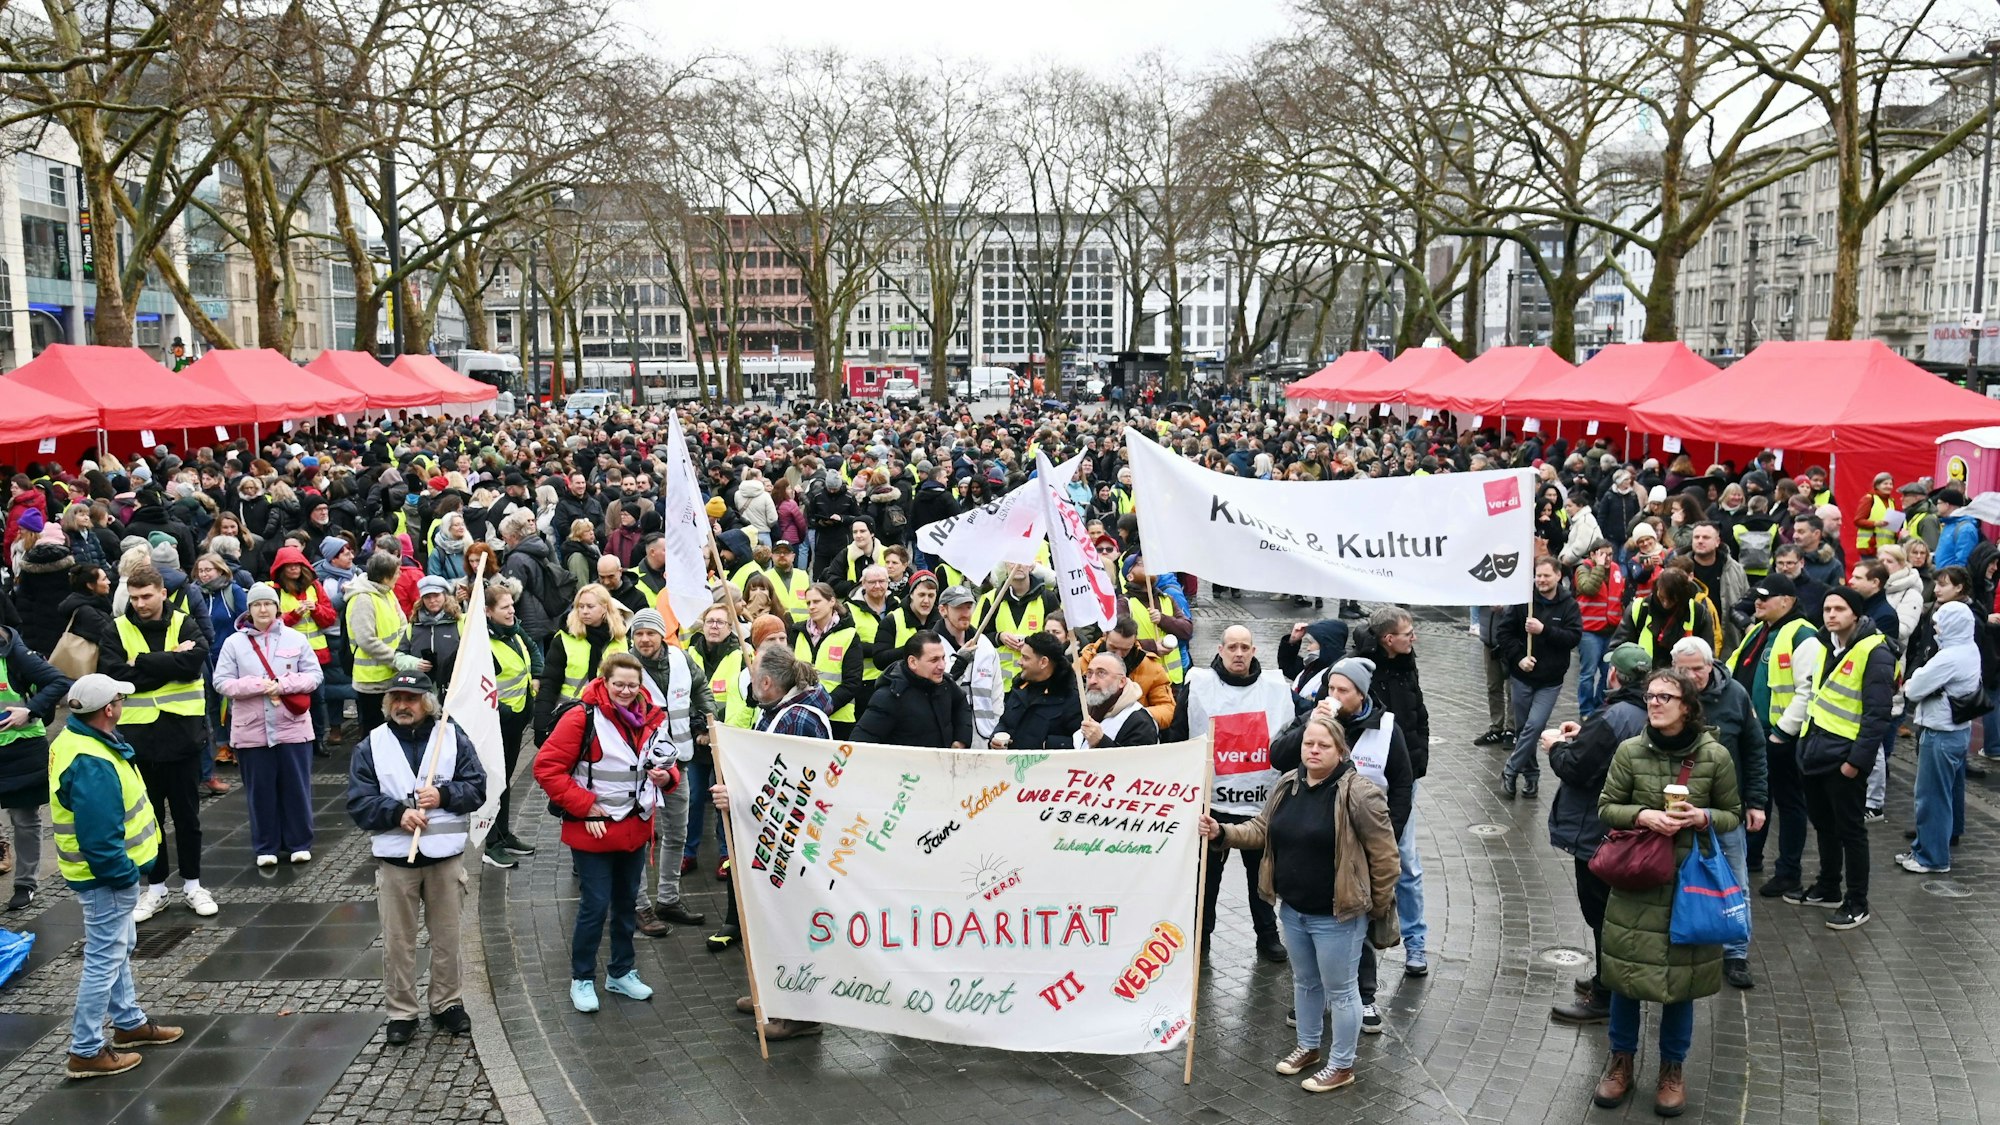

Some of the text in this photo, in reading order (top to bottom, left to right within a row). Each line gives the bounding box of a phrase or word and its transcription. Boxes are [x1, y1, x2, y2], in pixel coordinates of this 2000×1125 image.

[83, 234, 93, 264] Thalia
[1209, 494, 1448, 559] Kunst & Kultur
[1216, 747, 1268, 763] ver.di
[1067, 768, 1116, 792] FÜR
[1215, 785, 1269, 803] Streik
[801, 744, 854, 863] MEHR GELD
[827, 772, 921, 876] Mehr Freizeit
[1039, 807, 1181, 835] ÜBERNAHME
[769, 766, 817, 888] ANERKENNUNG
[774, 961, 1018, 1015] Wir sind es Wert
